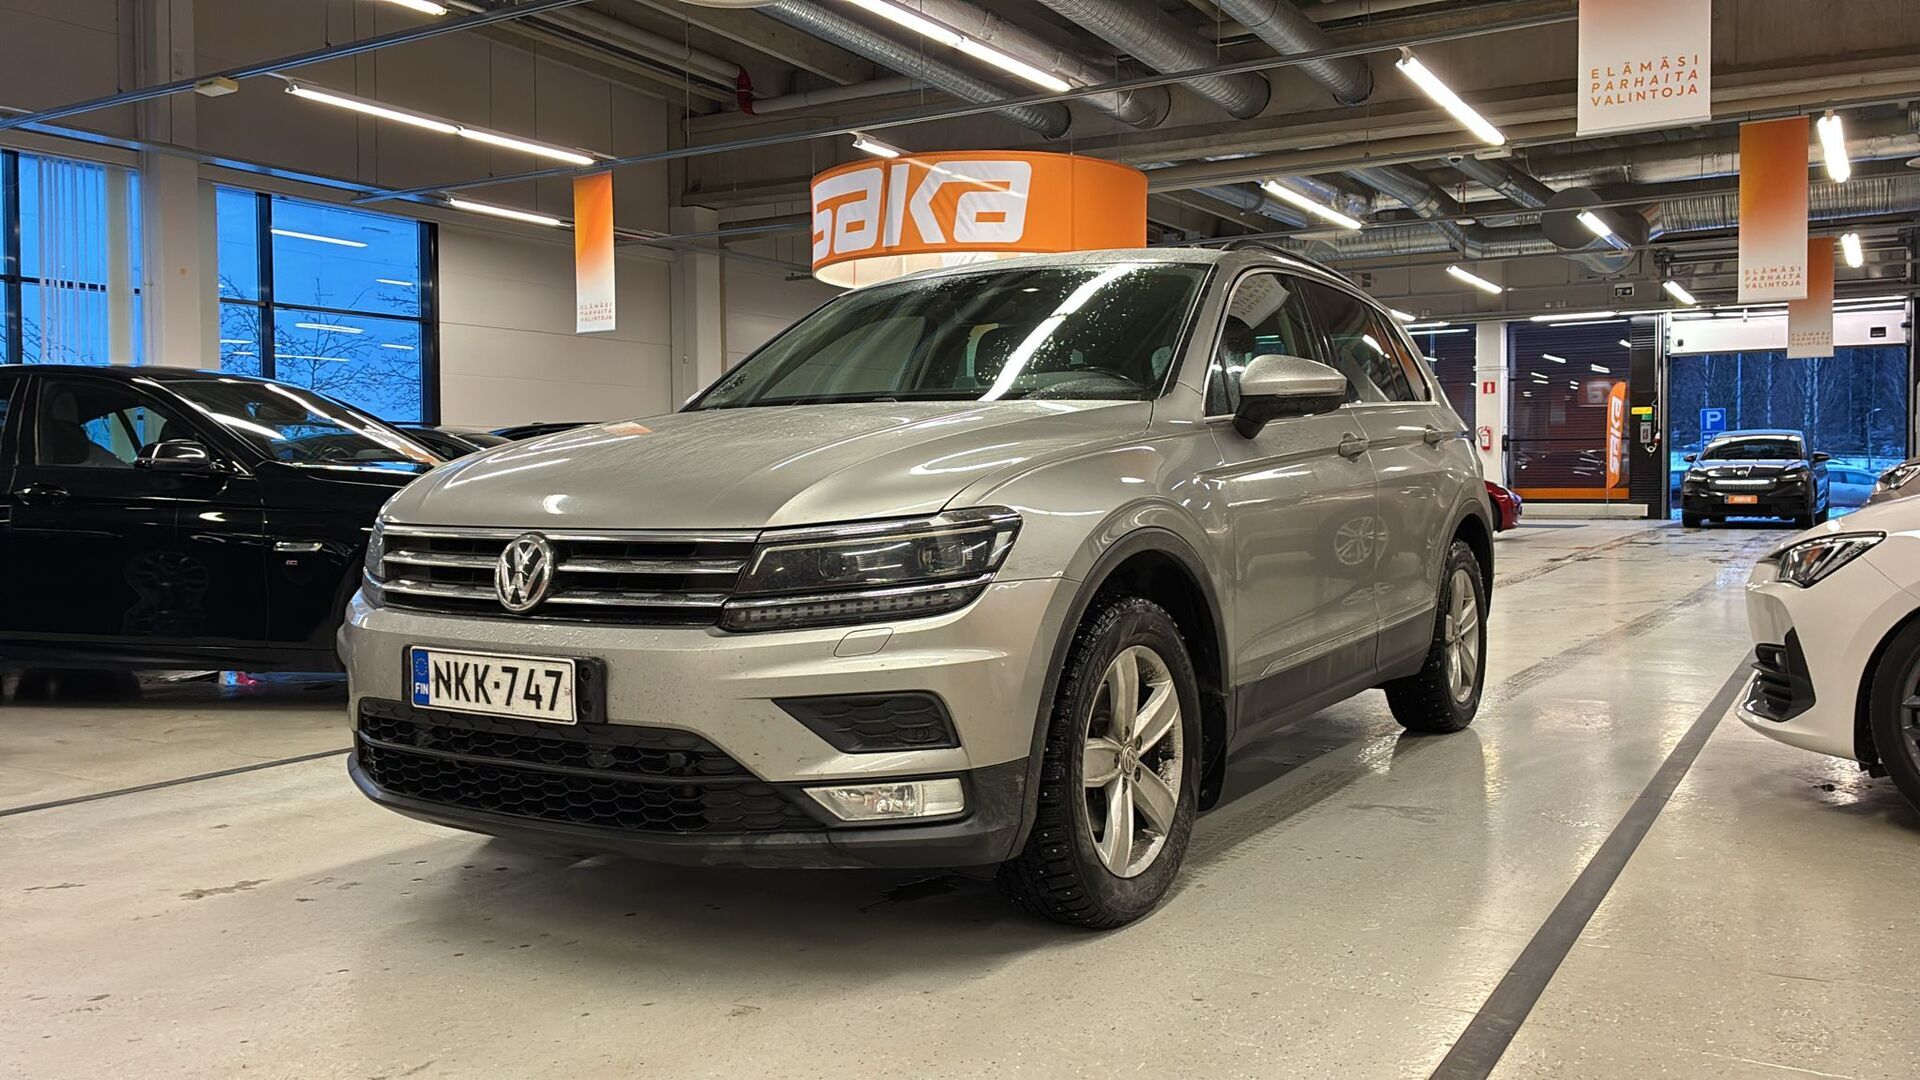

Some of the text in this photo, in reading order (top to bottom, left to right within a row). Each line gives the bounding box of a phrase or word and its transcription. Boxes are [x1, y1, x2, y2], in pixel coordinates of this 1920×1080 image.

[1591, 54, 1698, 79] ELÄMÄSI
[1591, 69, 1698, 93] PARHAITA
[1591, 84, 1698, 107] VALINTOJA
[1745, 266, 1801, 275] ELÄMÄSI
[1745, 274, 1801, 282] PARHAITA
[1745, 280, 1801, 288] VALINTOJA
[1706, 411, 1722, 430] P
[1609, 395, 1623, 475] saka
[415, 682, 429, 696] FIN
[433, 659, 563, 711] NKK-747
